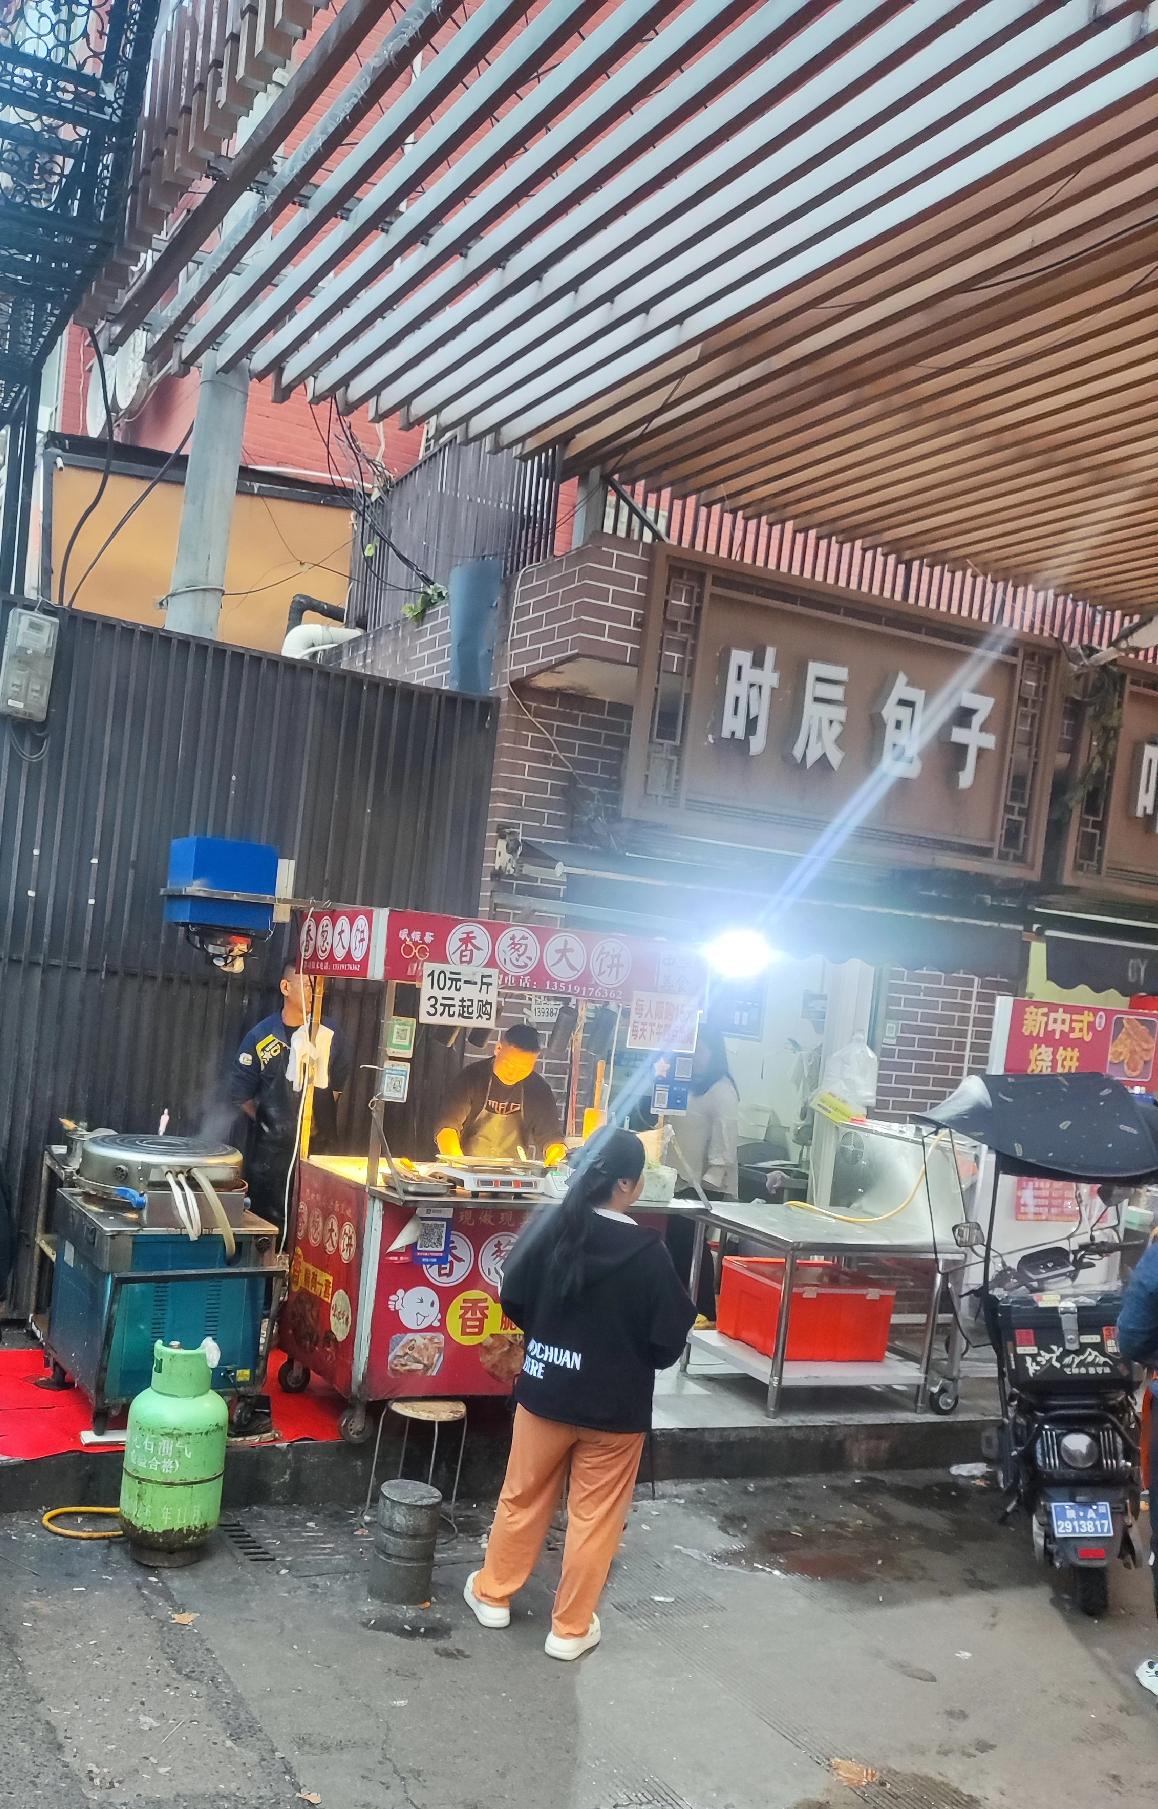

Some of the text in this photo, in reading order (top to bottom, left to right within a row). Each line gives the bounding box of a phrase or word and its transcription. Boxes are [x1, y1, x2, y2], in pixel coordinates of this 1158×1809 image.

[721, 645, 996, 789] 时辰包子
[449, 925, 629, 983] 香葱大饼
[427, 969, 493, 995] 10元一斤
[426, 995, 493, 1021] 3元起购
[1023, 1005, 1094, 1041] 新中式
[1027, 1043, 1080, 1073] 烧饼
[458, 1210, 530, 1226] 现做现
[1057, 1520, 1108, 1533] 2913817
